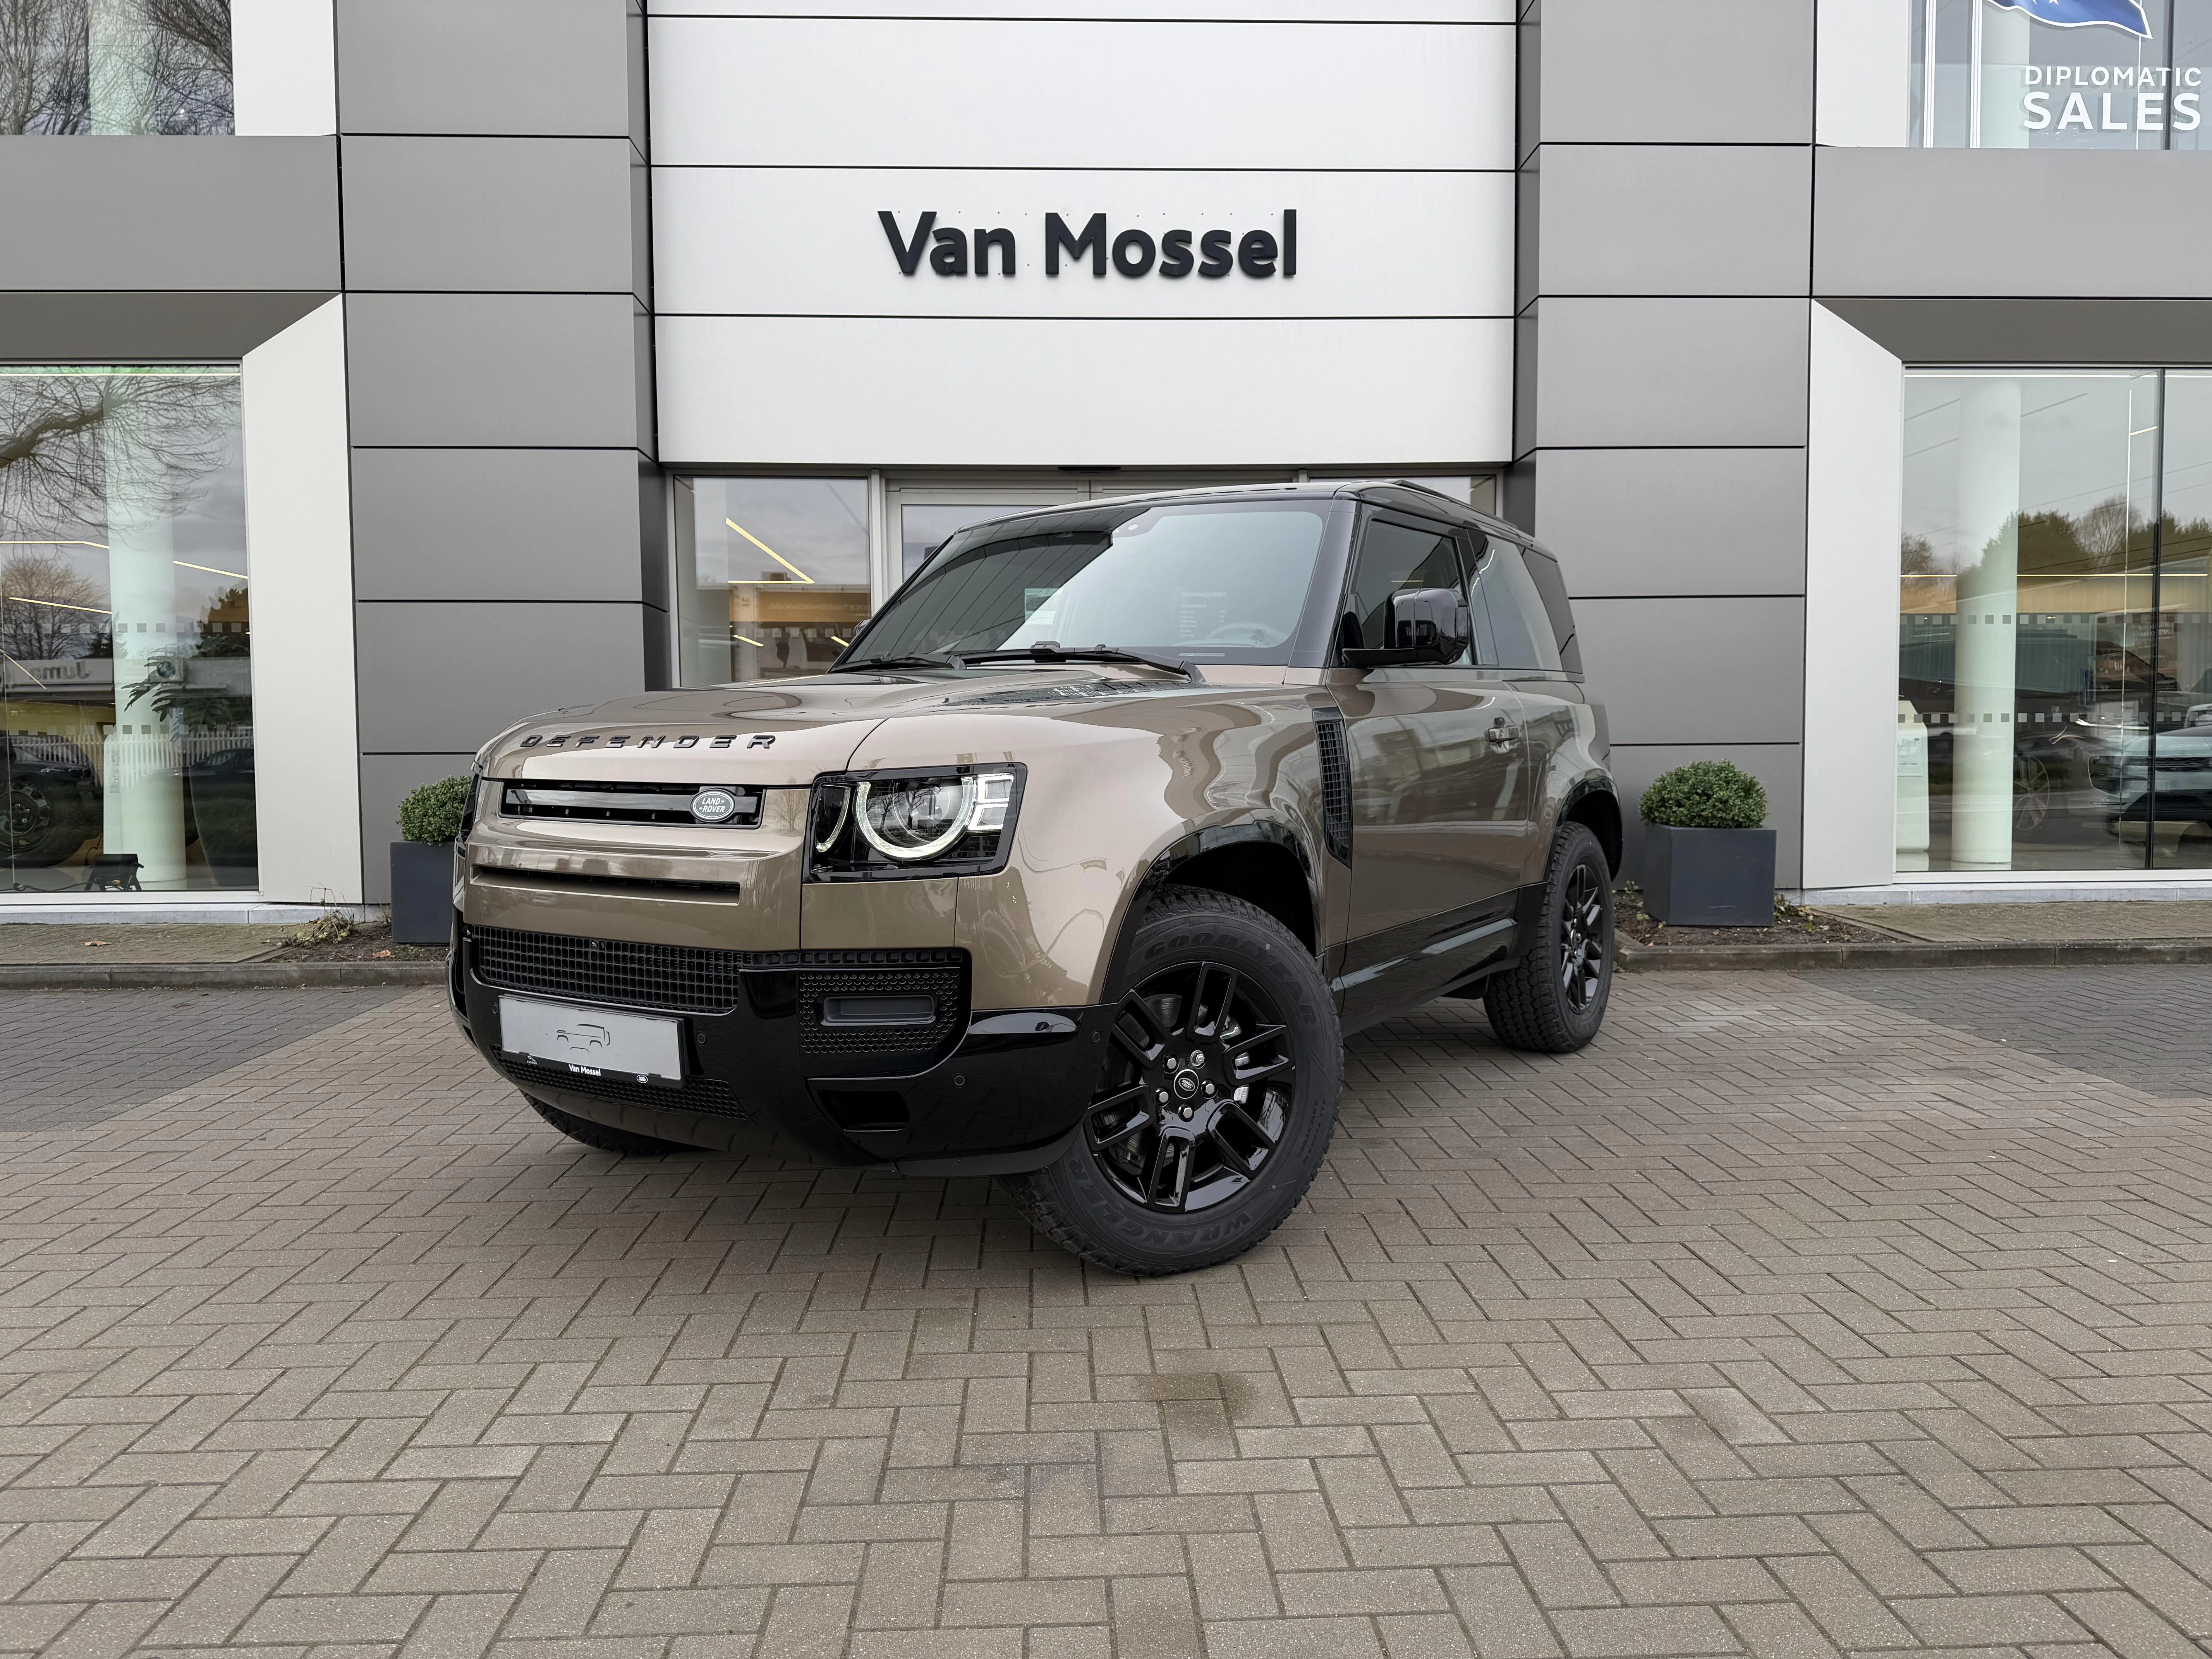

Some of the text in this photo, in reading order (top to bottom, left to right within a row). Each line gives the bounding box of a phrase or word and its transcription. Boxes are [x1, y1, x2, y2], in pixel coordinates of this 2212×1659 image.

[2025, 66, 2202, 86] DIPLOMATIC
[2023, 91, 2201, 131] SALES
[877, 209, 1297, 276] Van Mossel
[520, 735, 776, 749] DEFENDER
[701, 797, 721, 805] LAND
[1144, 932, 1316, 1025] GOODYEAR
[568, 1064, 601, 1076] Van Mossel
[1069, 1159, 1252, 1247] WRANGLER
